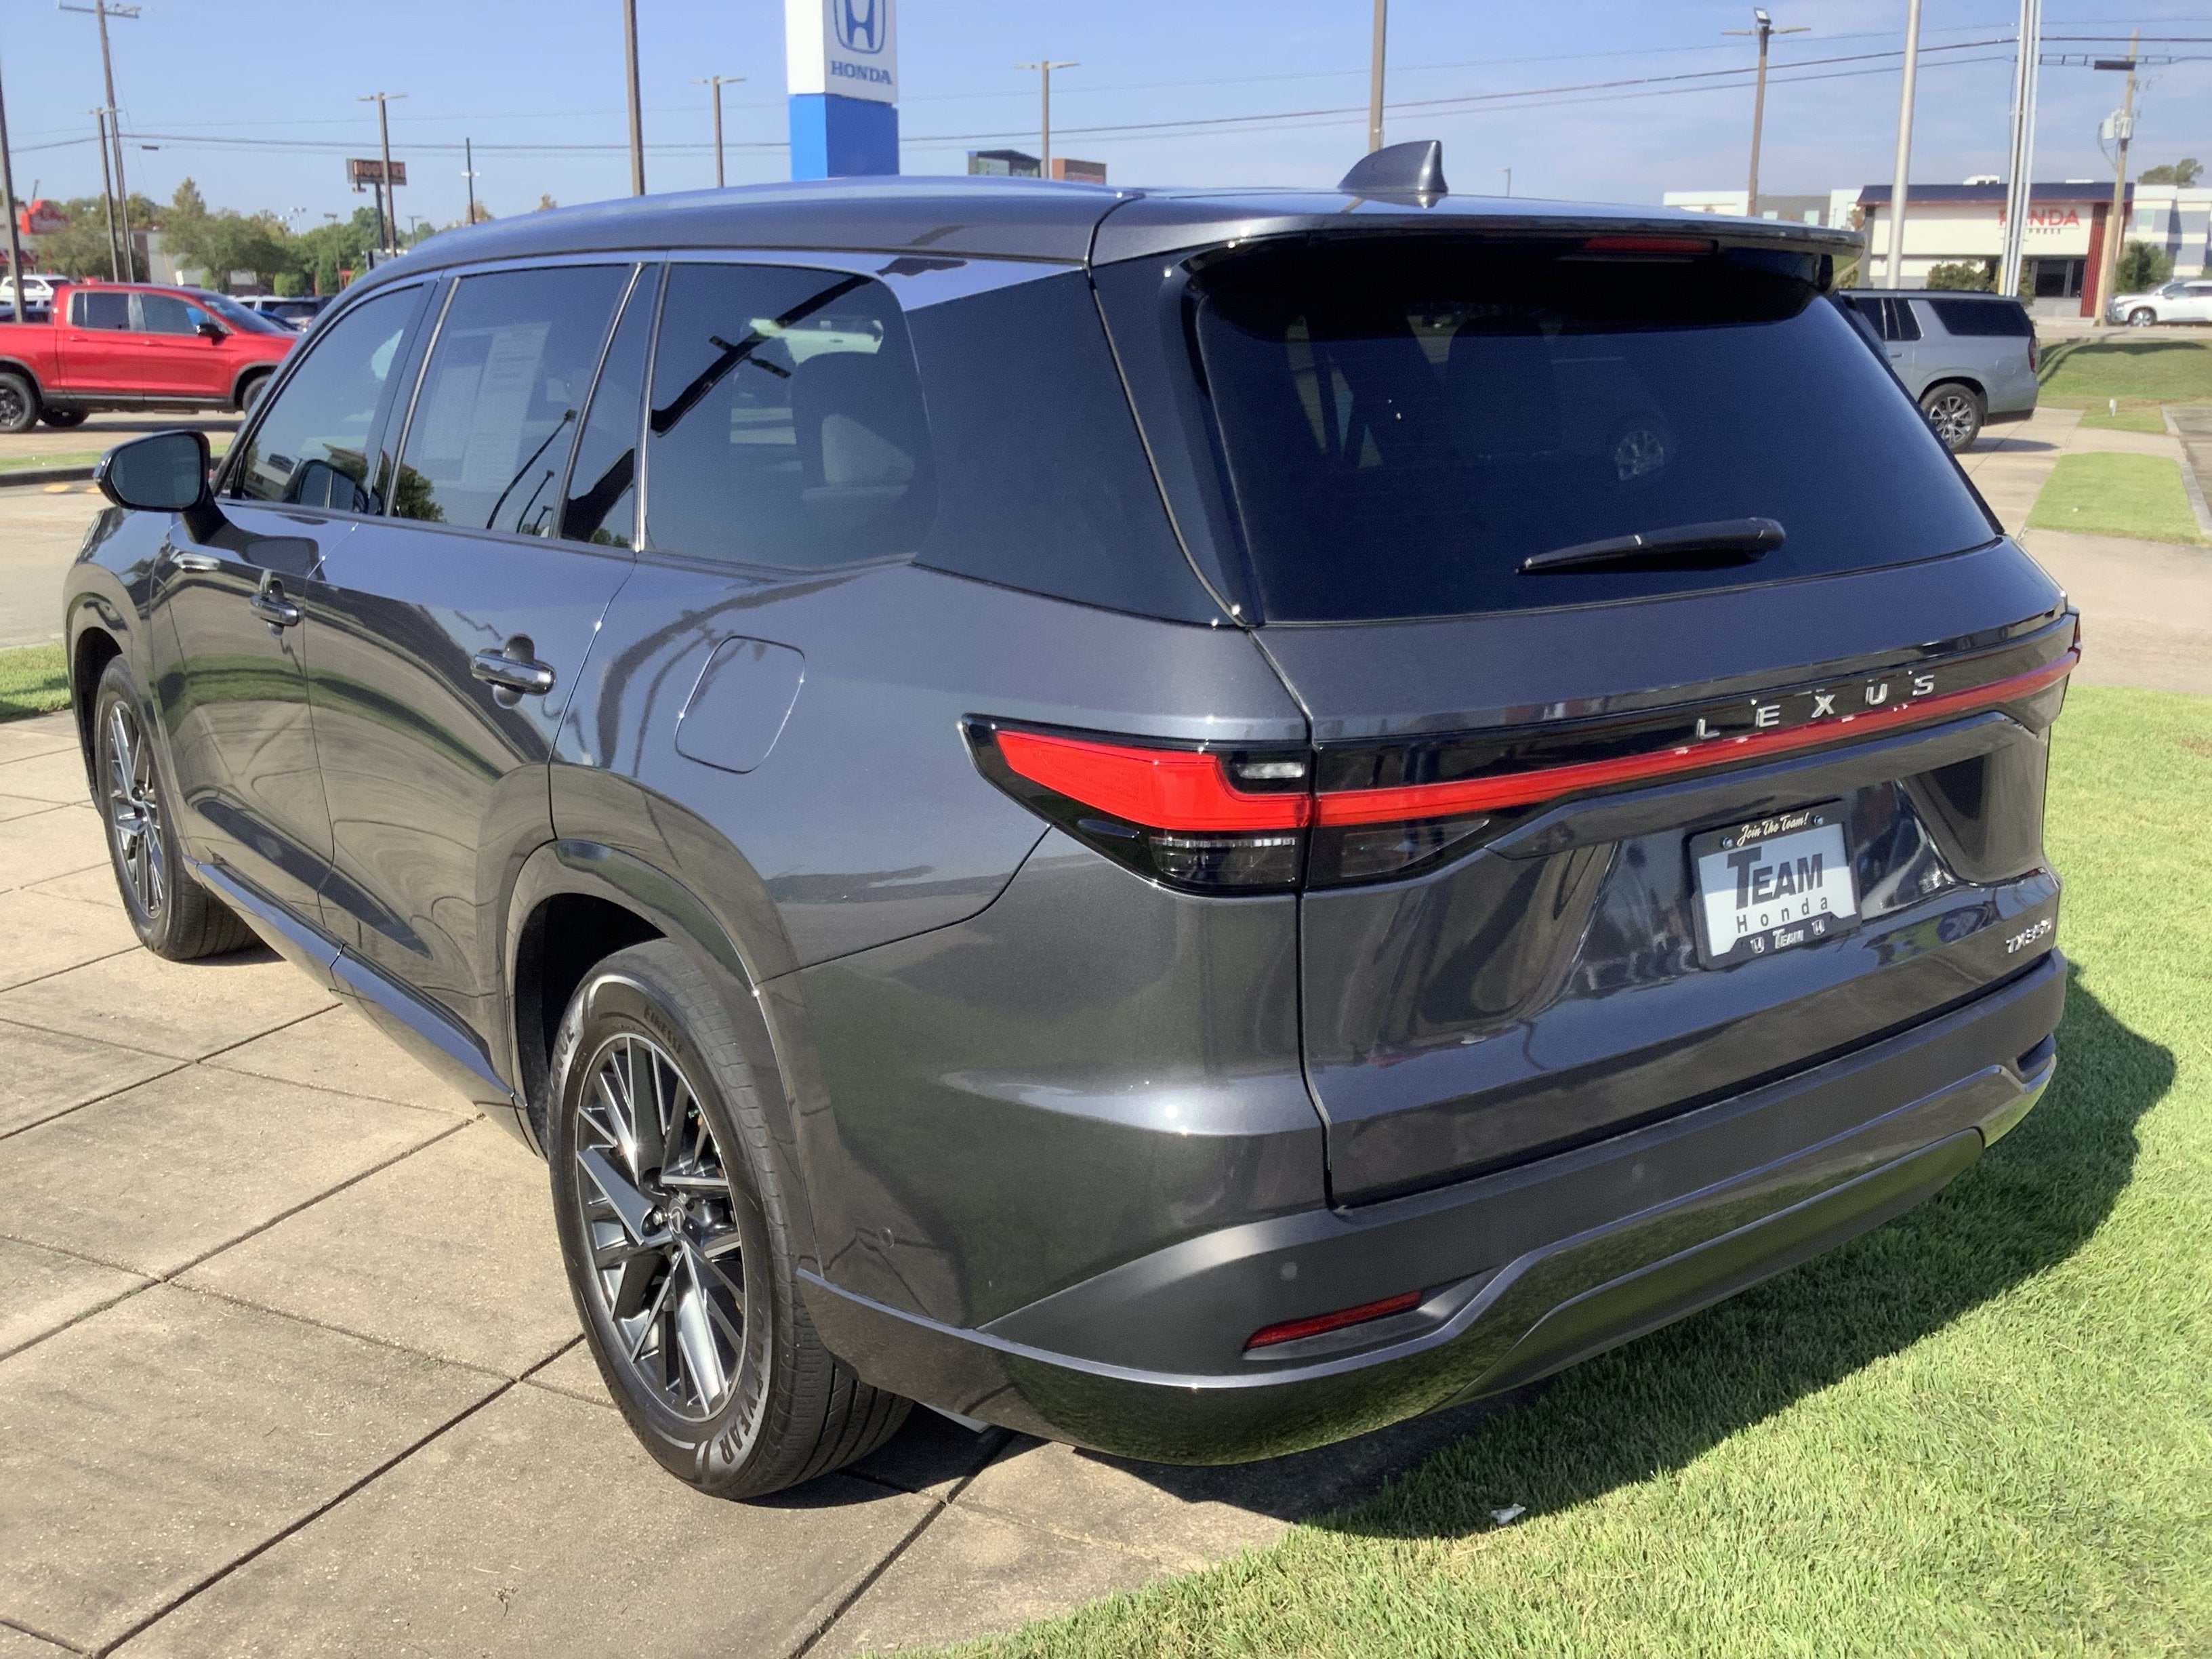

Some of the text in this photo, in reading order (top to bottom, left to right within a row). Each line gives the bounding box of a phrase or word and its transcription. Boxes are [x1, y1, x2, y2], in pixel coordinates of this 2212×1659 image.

[831, 60, 893, 85] HONDA
[1998, 209, 2080, 226] HNDA
[1696, 674, 1934, 739] LEXUS
[1736, 812, 1810, 846] Join The Team!
[1727, 846, 1823, 909] TEAM
[1736, 897, 1828, 933] Honda
[1773, 928, 1804, 949] TEAM
